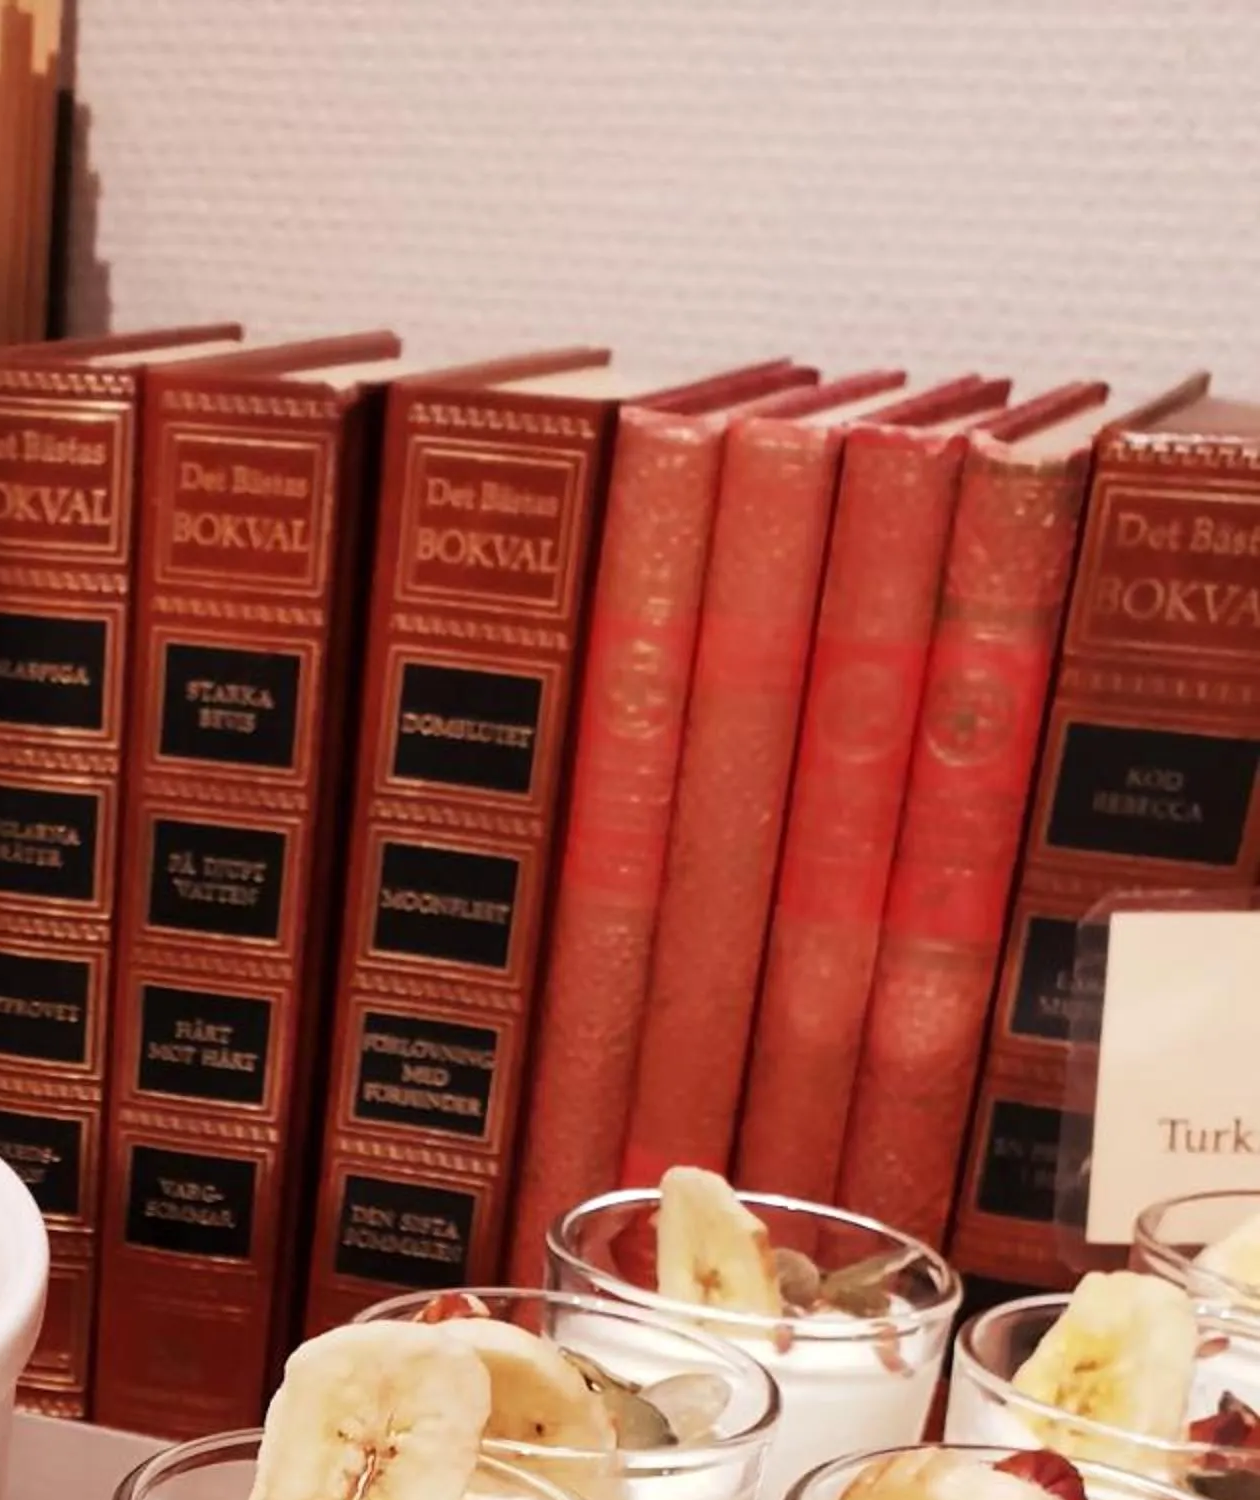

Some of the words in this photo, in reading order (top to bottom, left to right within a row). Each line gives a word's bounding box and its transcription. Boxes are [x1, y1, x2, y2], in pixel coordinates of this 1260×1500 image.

[181, 462, 227, 491] Det
[427, 477, 475, 510] Det
[173, 511, 311, 552] BOKVAL
[417, 527, 559, 573] BOKVAL
[1117, 511, 1181, 552] Det
